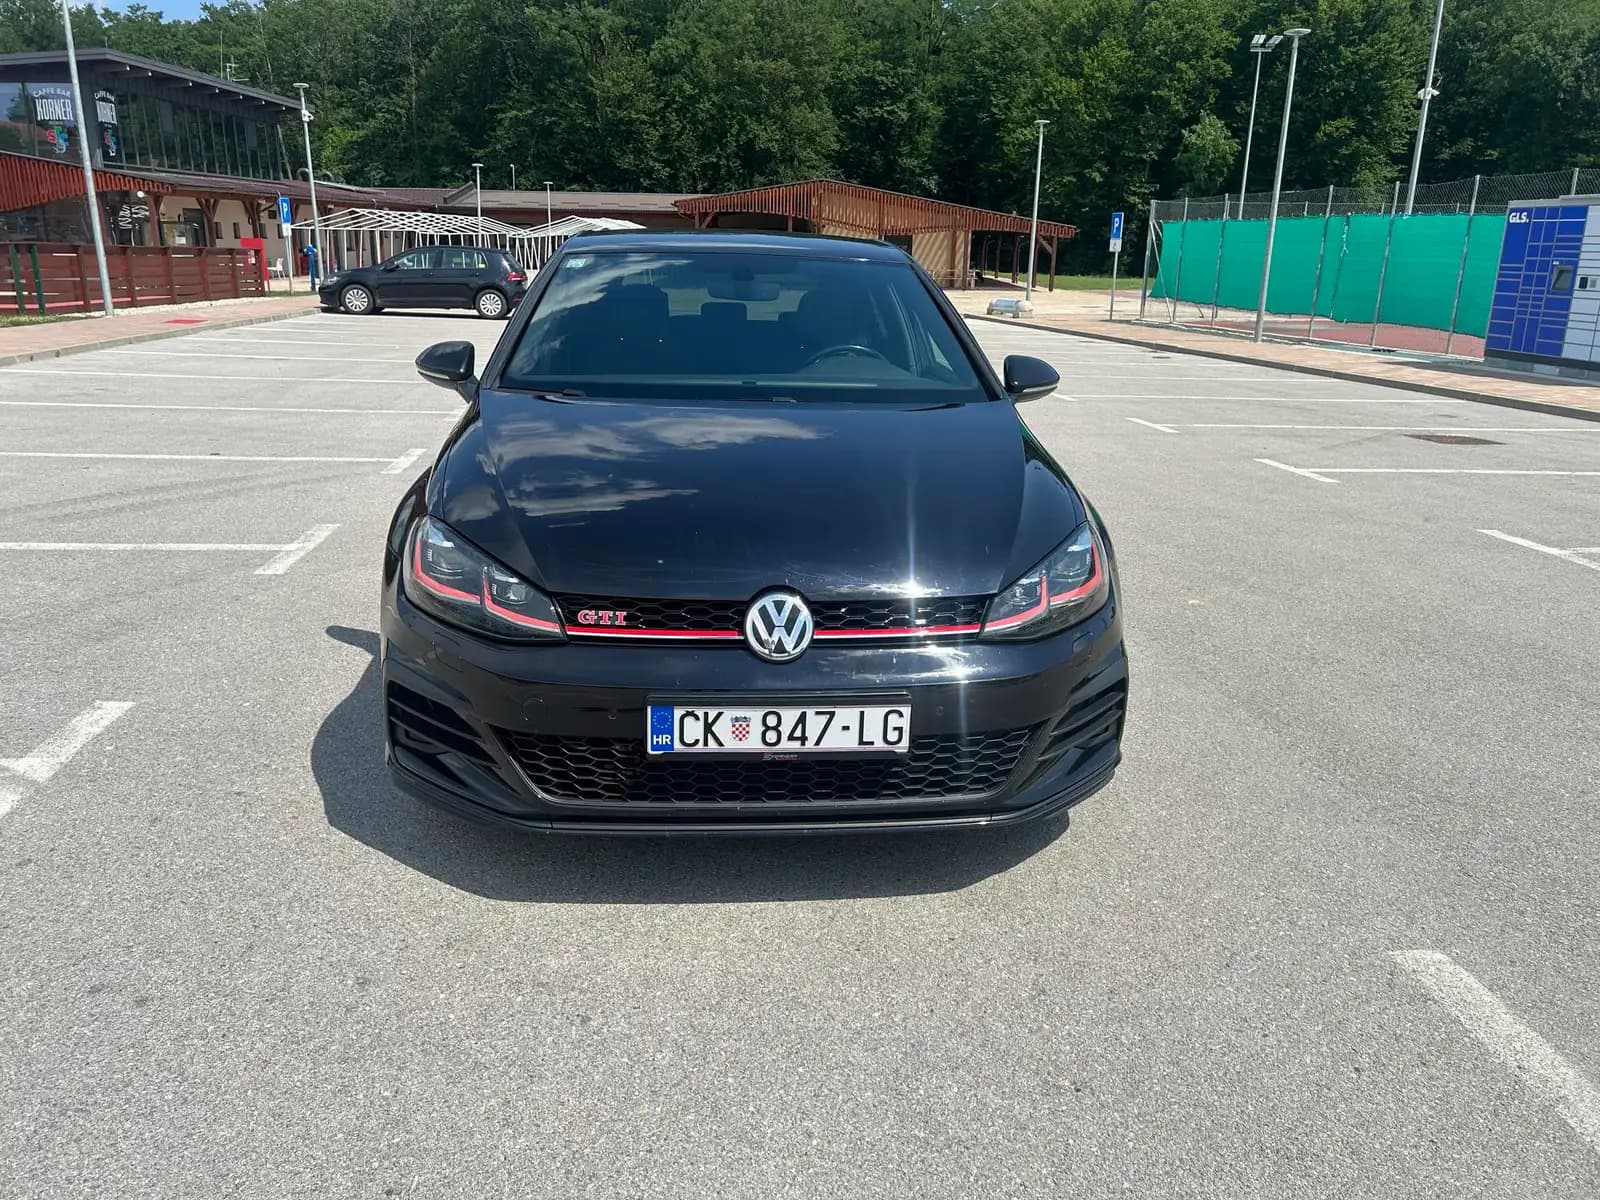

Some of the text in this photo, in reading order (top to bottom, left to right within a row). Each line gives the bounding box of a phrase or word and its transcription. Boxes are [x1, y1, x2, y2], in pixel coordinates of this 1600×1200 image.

[36, 99, 73, 120] KORNER
[283, 203, 288, 218] P
[1114, 218, 1120, 232] P
[577, 609, 627, 626] GTI
[679, 709, 904, 747] ČK 847-LG
[653, 734, 671, 745] HR
